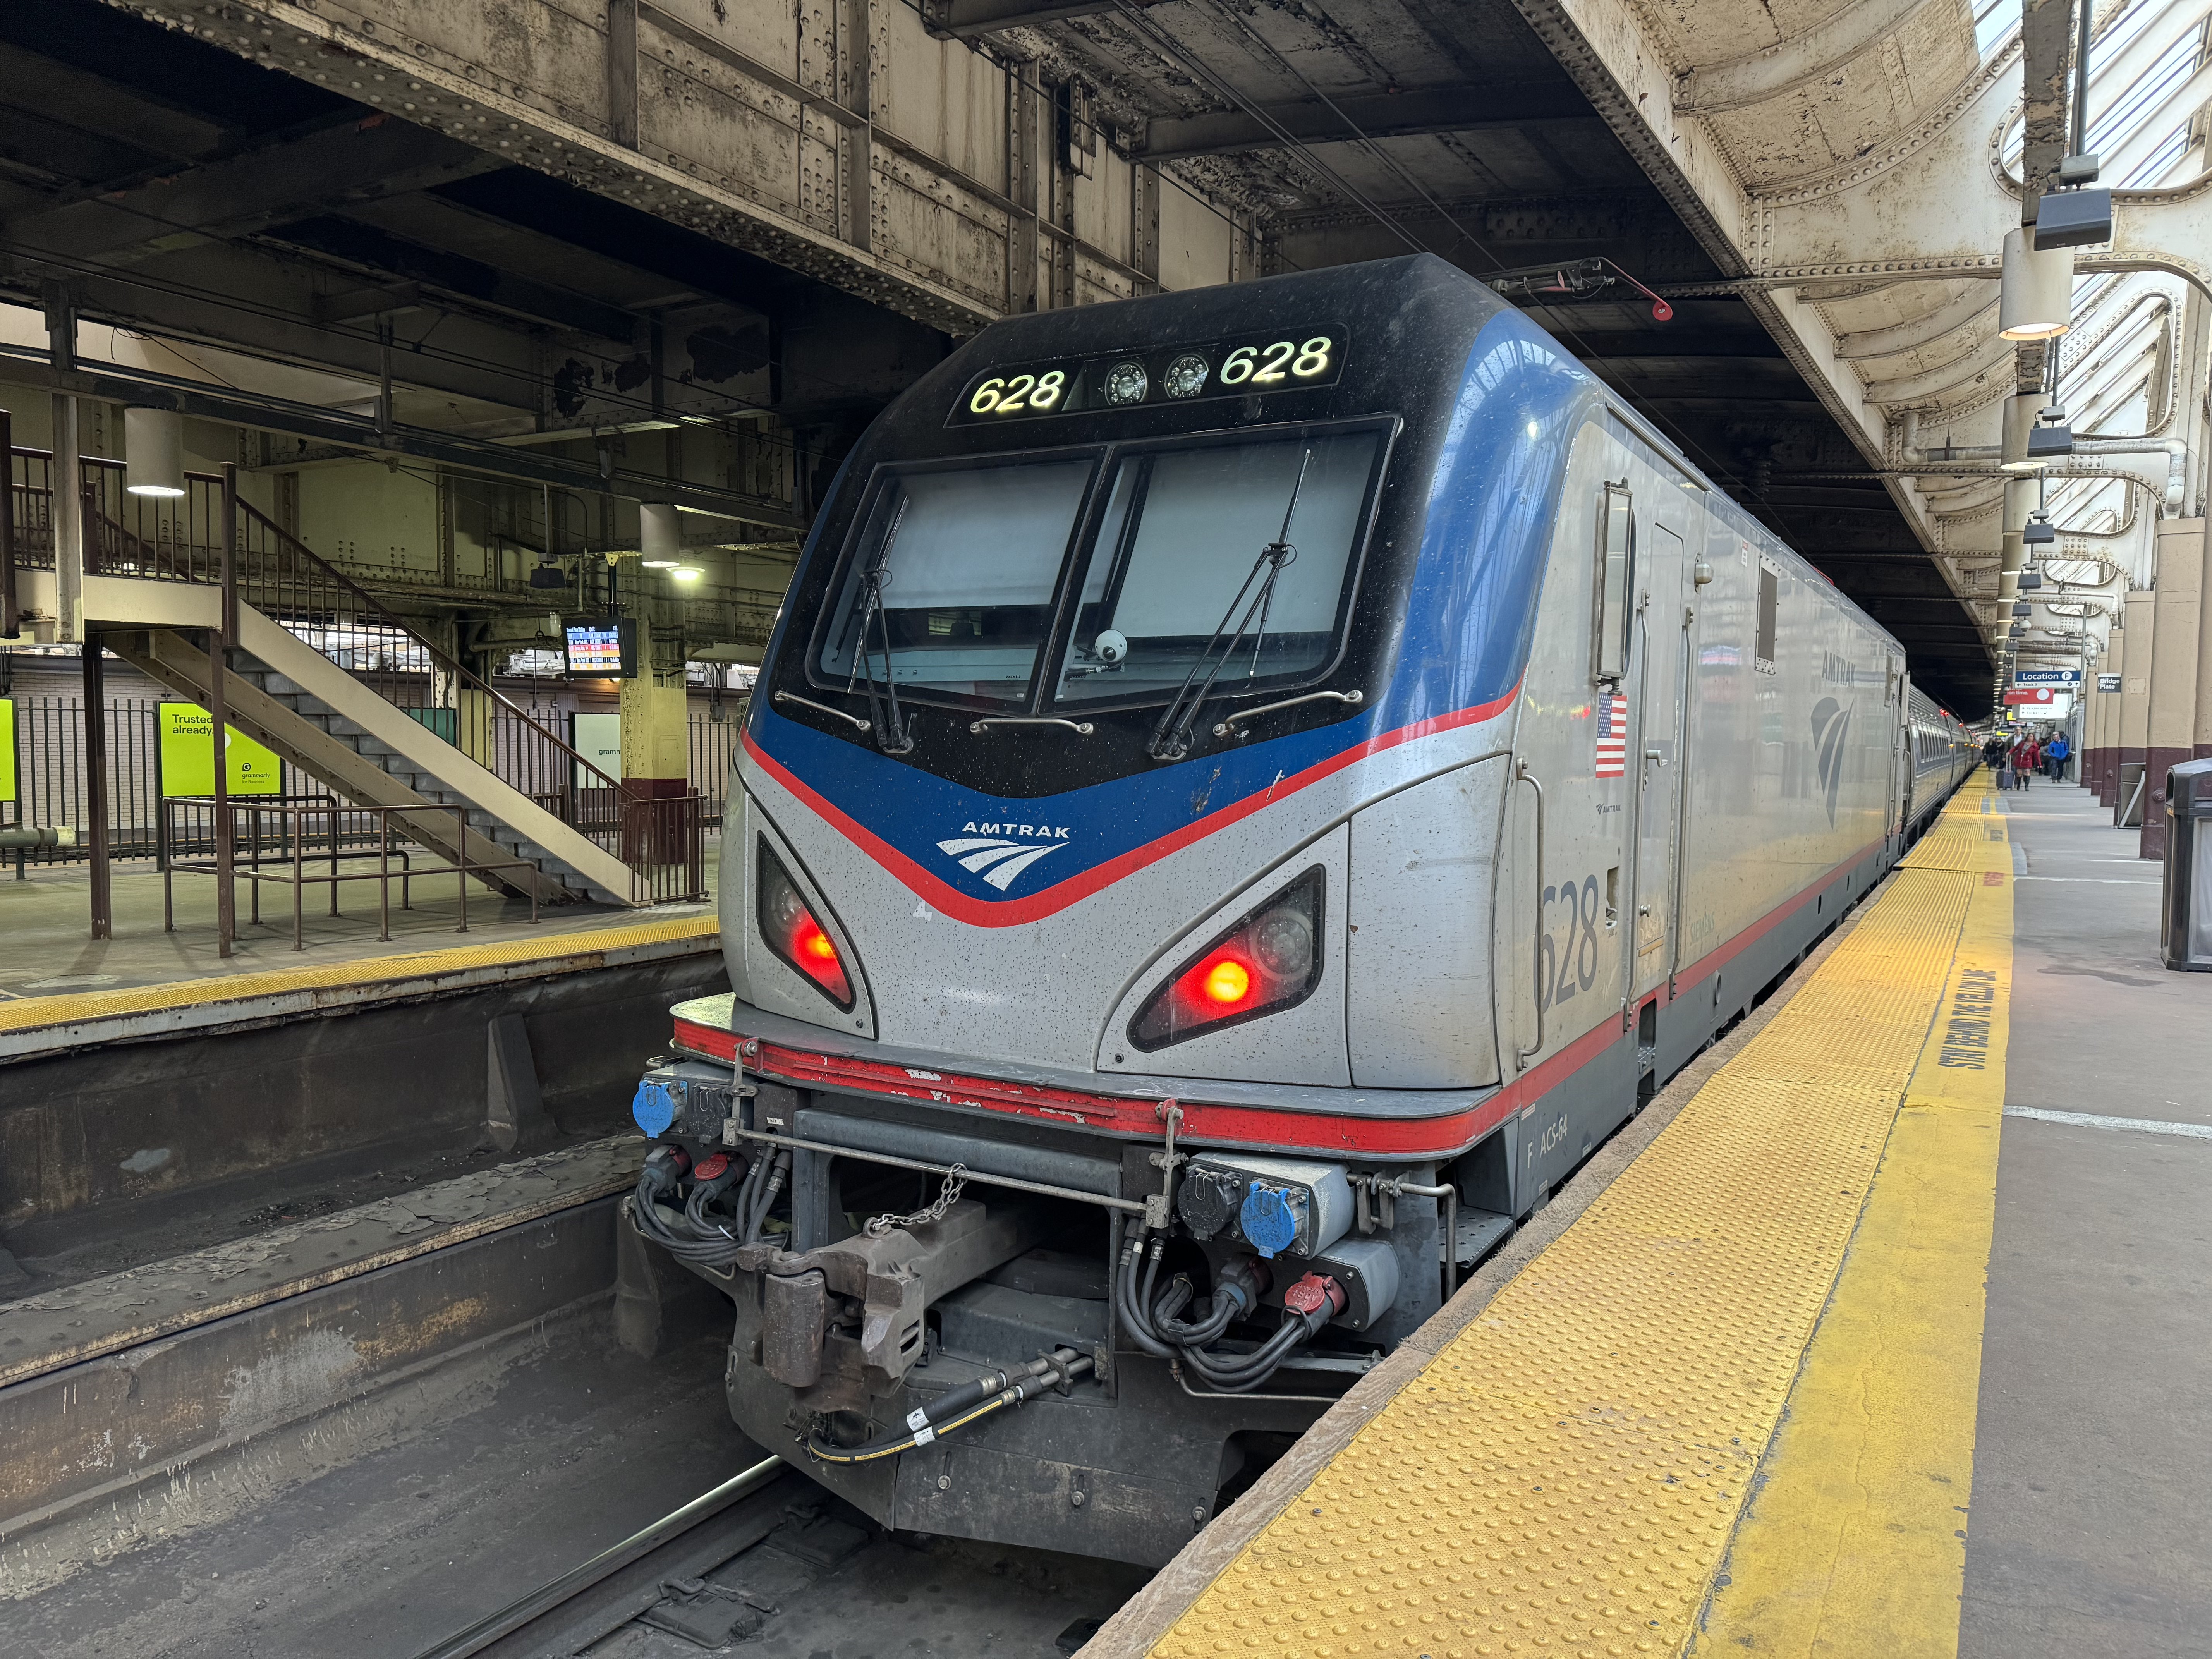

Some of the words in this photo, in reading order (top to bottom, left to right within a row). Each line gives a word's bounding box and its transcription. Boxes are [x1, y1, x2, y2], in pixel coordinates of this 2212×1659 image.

[1220, 337, 1331, 385] 628
[970, 371, 1065, 414] 628
[1822, 649, 1856, 689] AMTRAK
[172, 714, 213, 723] Trusted
[173, 725, 214, 736] already.
[1603, 804, 1621, 813] AMTRAK
[962, 821, 1070, 838] AMTRAK
[1533, 874, 1599, 1015] 628
[1962, 969, 1996, 981] LINE
[1954, 980, 1995, 1003] YELLOW
[1951, 1003, 1991, 1017] THE
[1944, 1018, 1990, 1048] BEHIND
[1938, 1046, 1986, 1070] STAY
[1527, 1141, 1533, 1169] F
[1540, 1113, 1568, 1158] ACS-64
